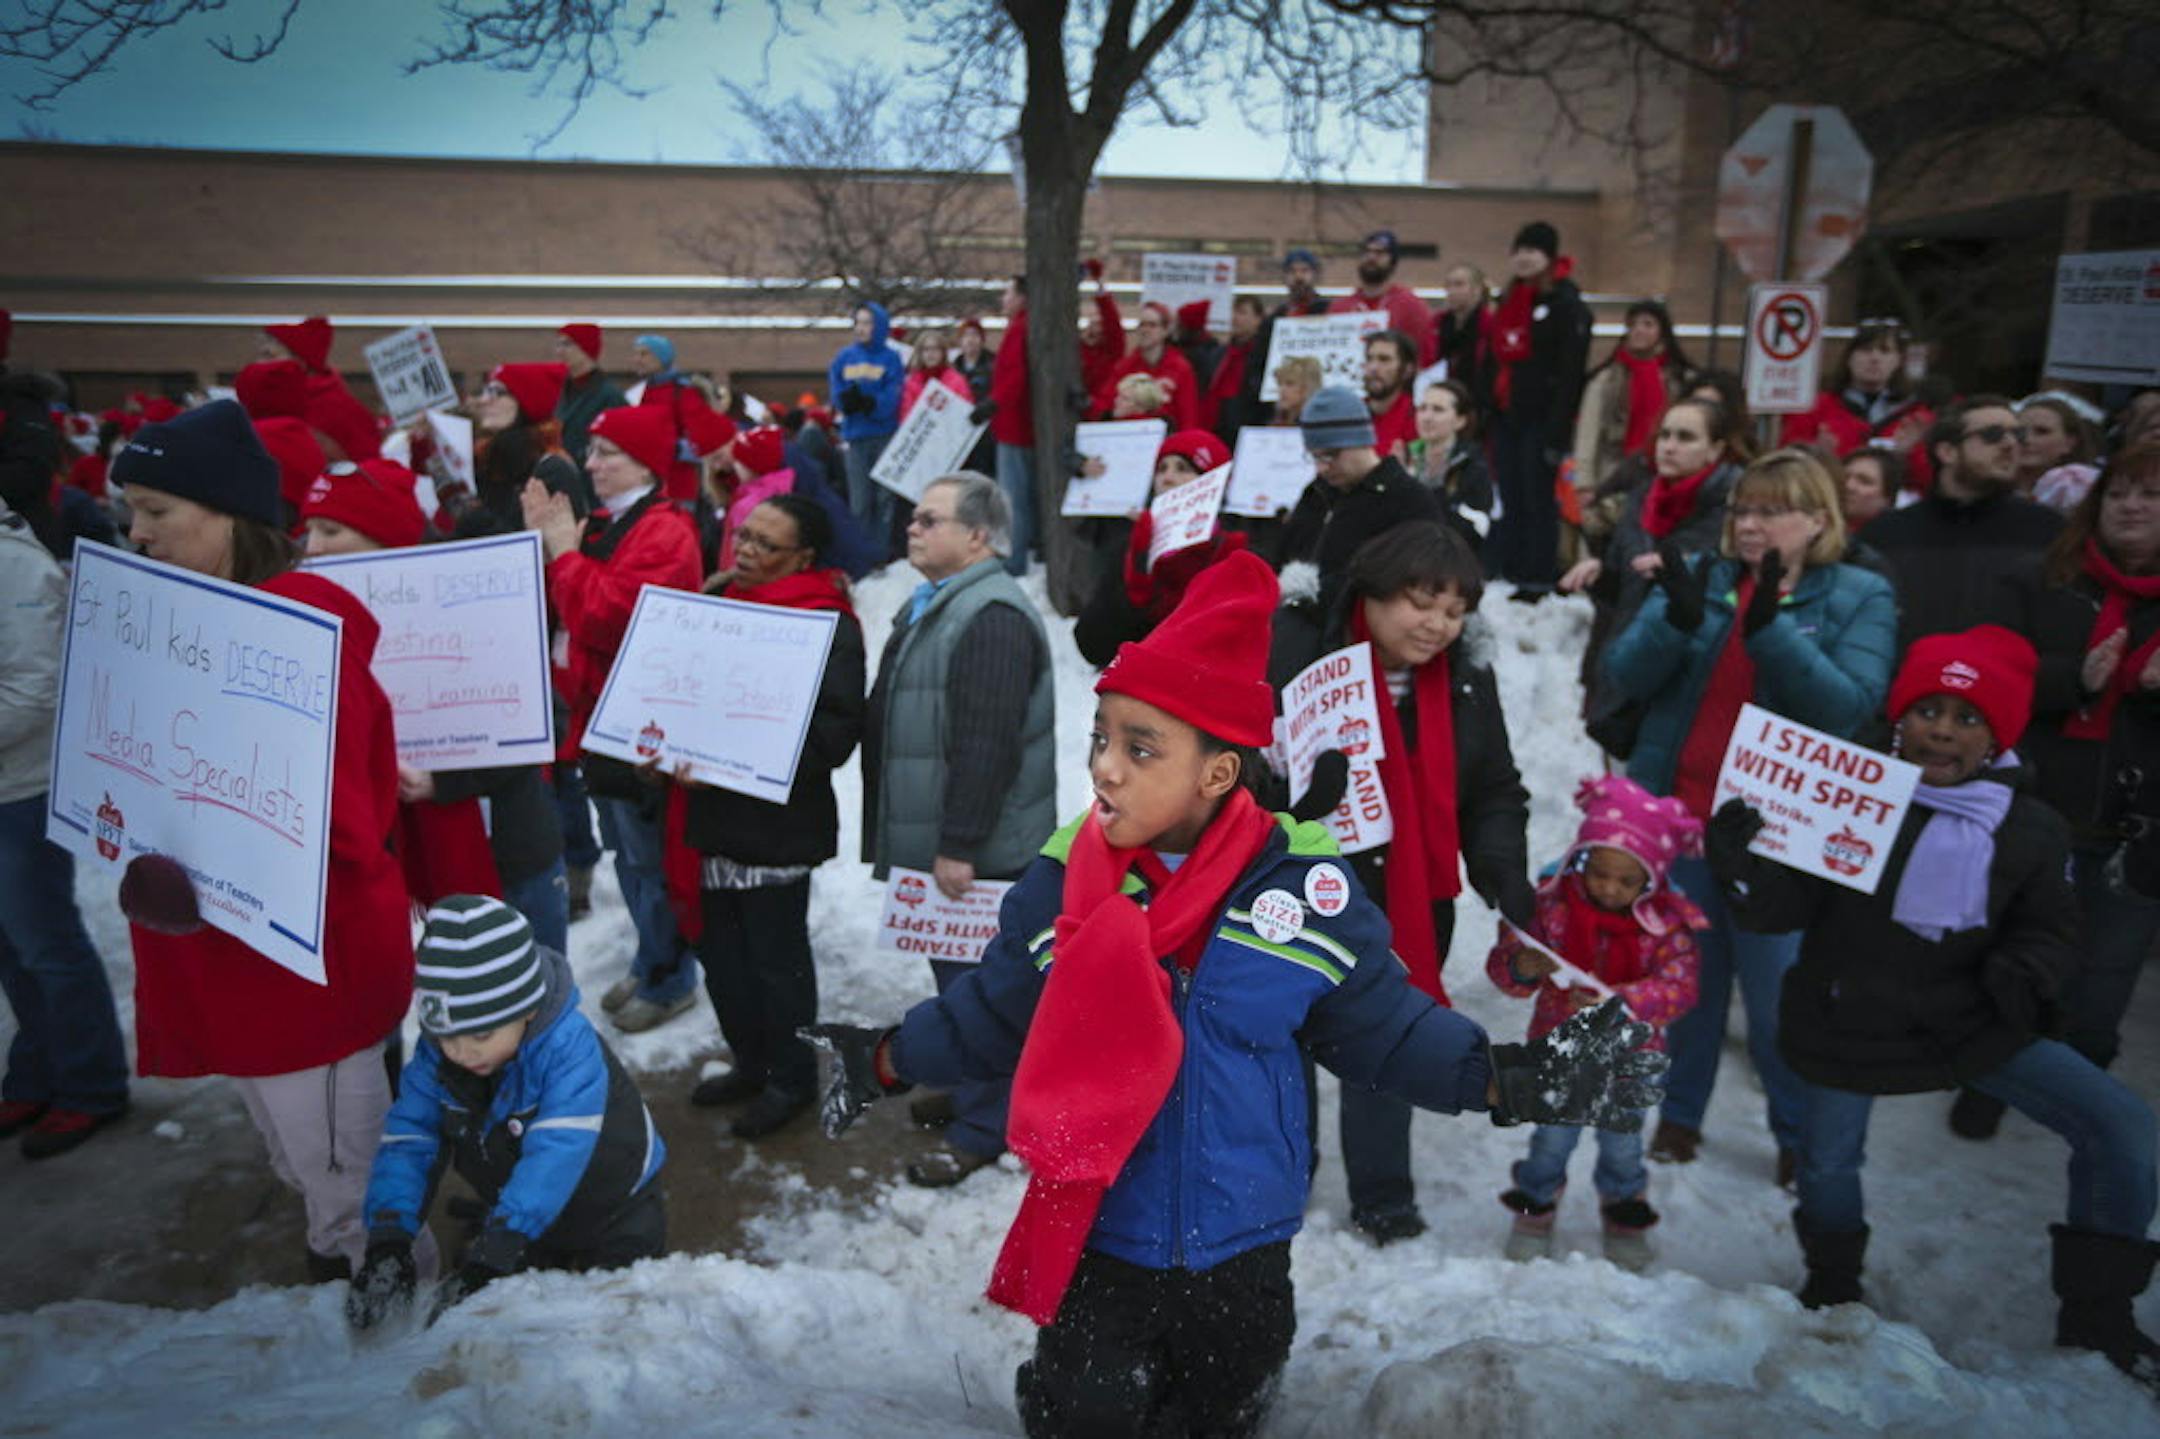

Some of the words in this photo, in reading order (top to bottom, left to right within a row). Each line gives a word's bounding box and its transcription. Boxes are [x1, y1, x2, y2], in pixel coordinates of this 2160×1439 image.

[366, 573, 421, 608] kids
[433, 567, 531, 602] DESERVE
[115, 590, 153, 654] Paul
[167, 607, 213, 673] kids
[226, 640, 328, 715] DESERVE
[378, 622, 465, 675] esting
[427, 675, 521, 718] Learning
[1299, 656, 1351, 701] STAND
[85, 661, 156, 770] Media
[1289, 700, 1317, 742] WITH
[1320, 680, 1367, 715] SPFT
[168, 707, 306, 838] Specialists
[1760, 720, 1772, 743] I
[1775, 728, 1885, 785] STAND
[1351, 766, 1384, 823] AND
[1732, 745, 1806, 795] WITH
[1810, 780, 1896, 826] SPFT
[1335, 802, 1361, 845] PFT
[885, 913, 939, 935] SPFT
[944, 922, 1001, 939] WITH
[1257, 898, 1300, 928] SIZE
[896, 935, 969, 957] STAND
